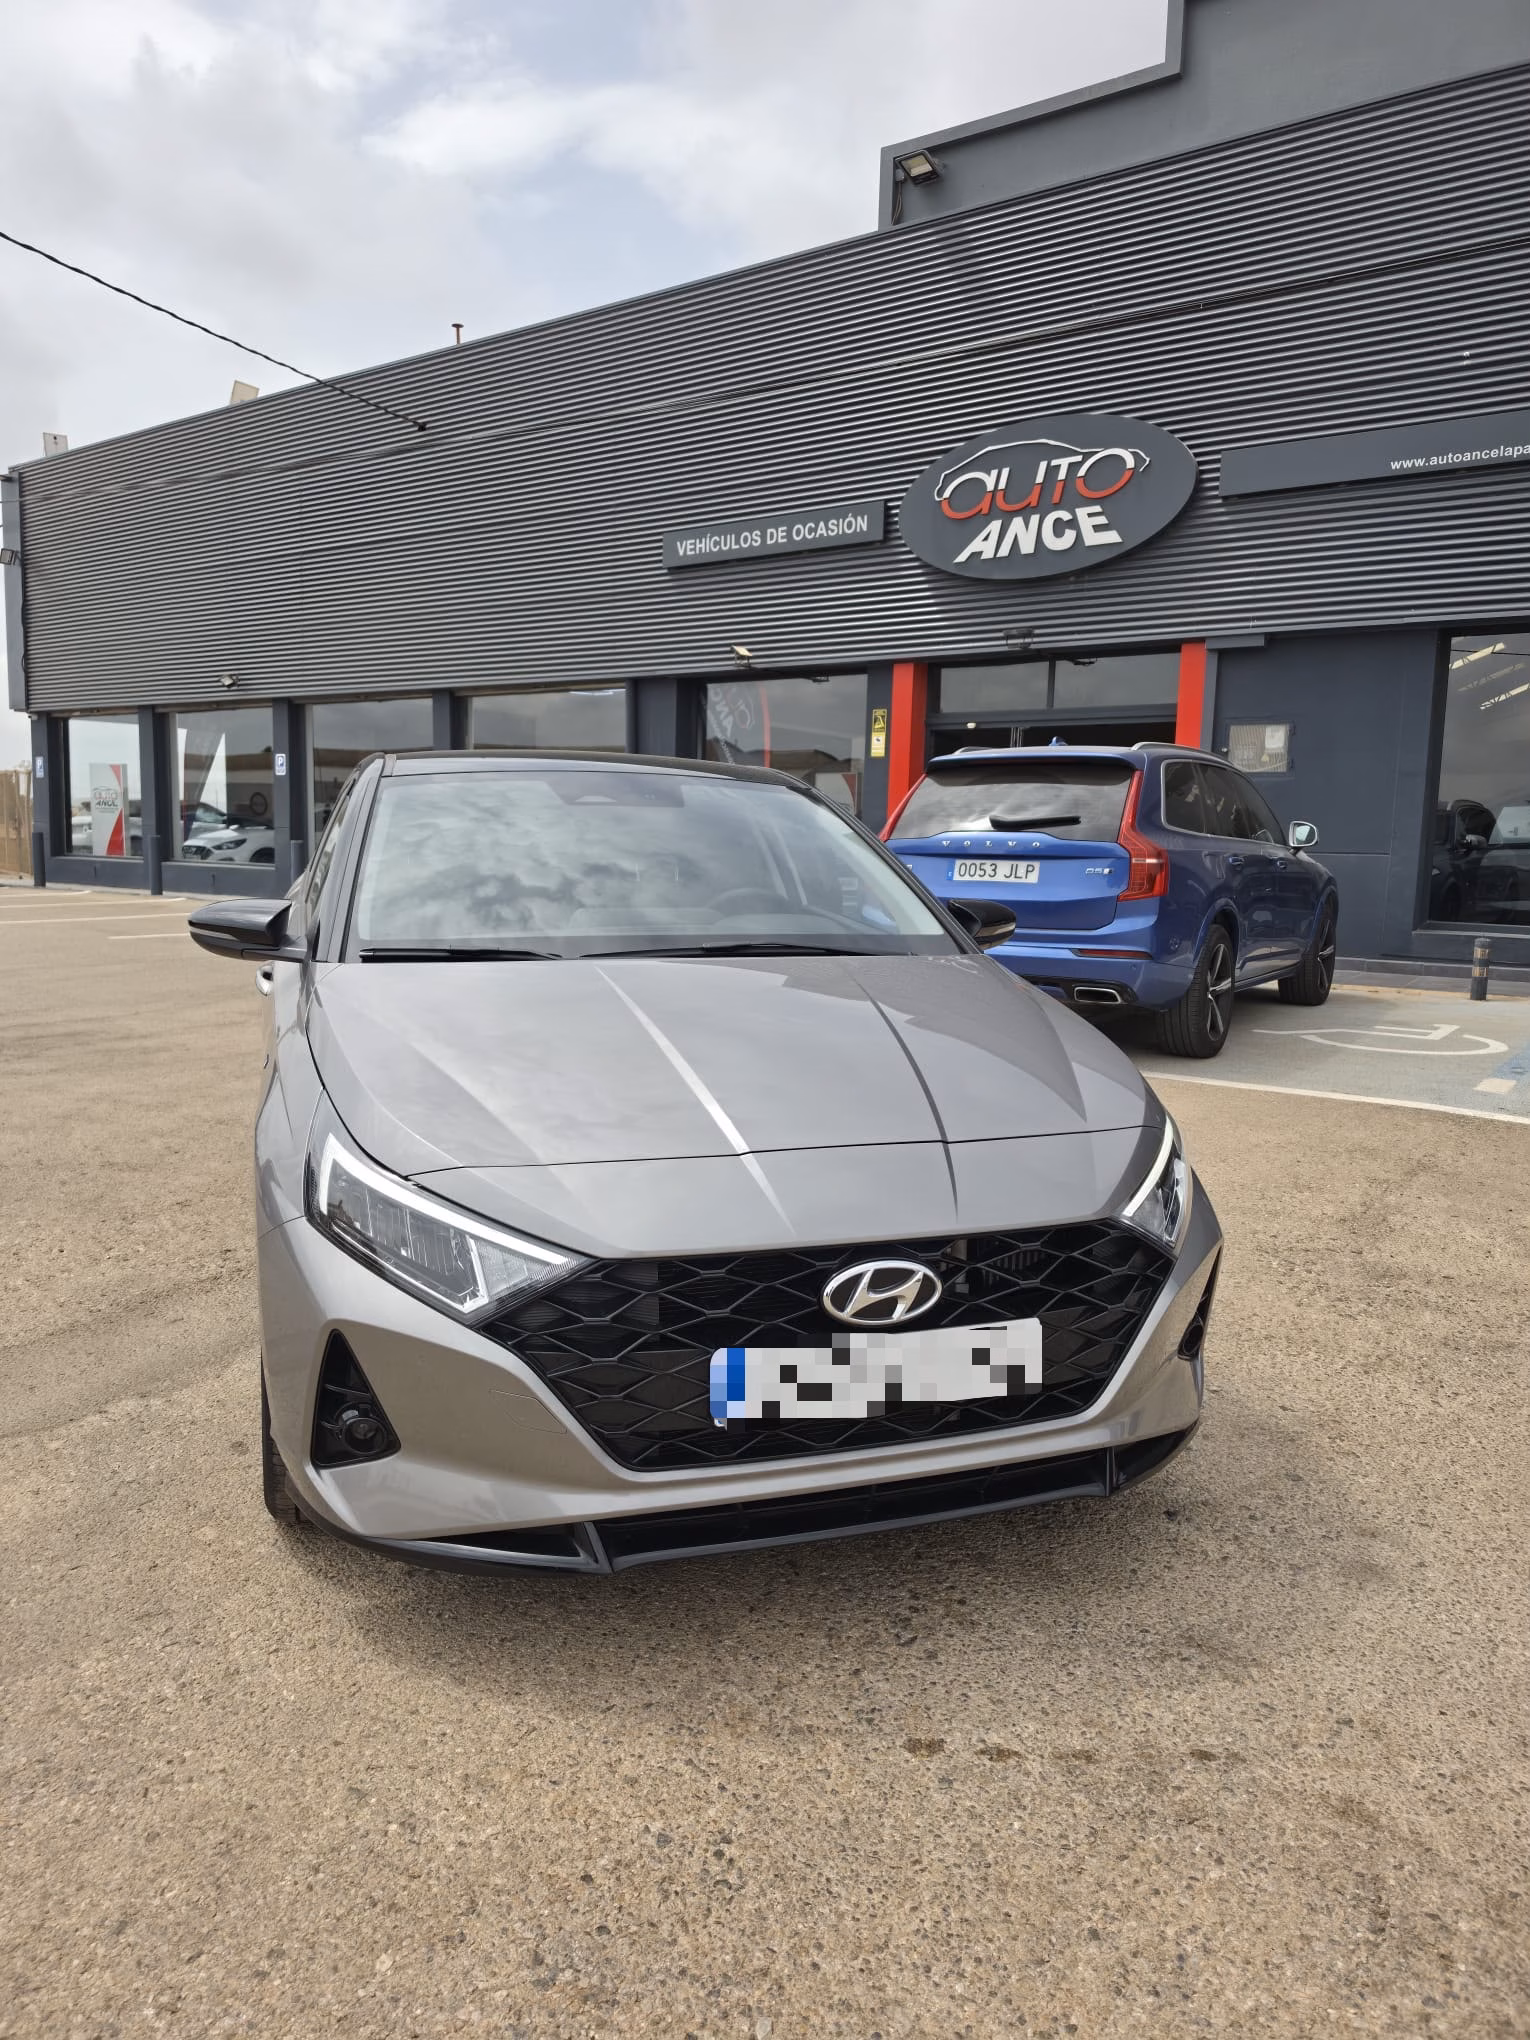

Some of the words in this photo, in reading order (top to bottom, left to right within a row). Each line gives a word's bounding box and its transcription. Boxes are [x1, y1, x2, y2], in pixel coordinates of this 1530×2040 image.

[676, 530, 761, 556] VEHÍCULOS
[766, 526, 788, 545] DE
[792, 513, 868, 541] OCASIÓN
[953, 505, 1123, 563] ANCE
[958, 862, 998, 878] 0053
[1003, 863, 1035, 880] JLP
